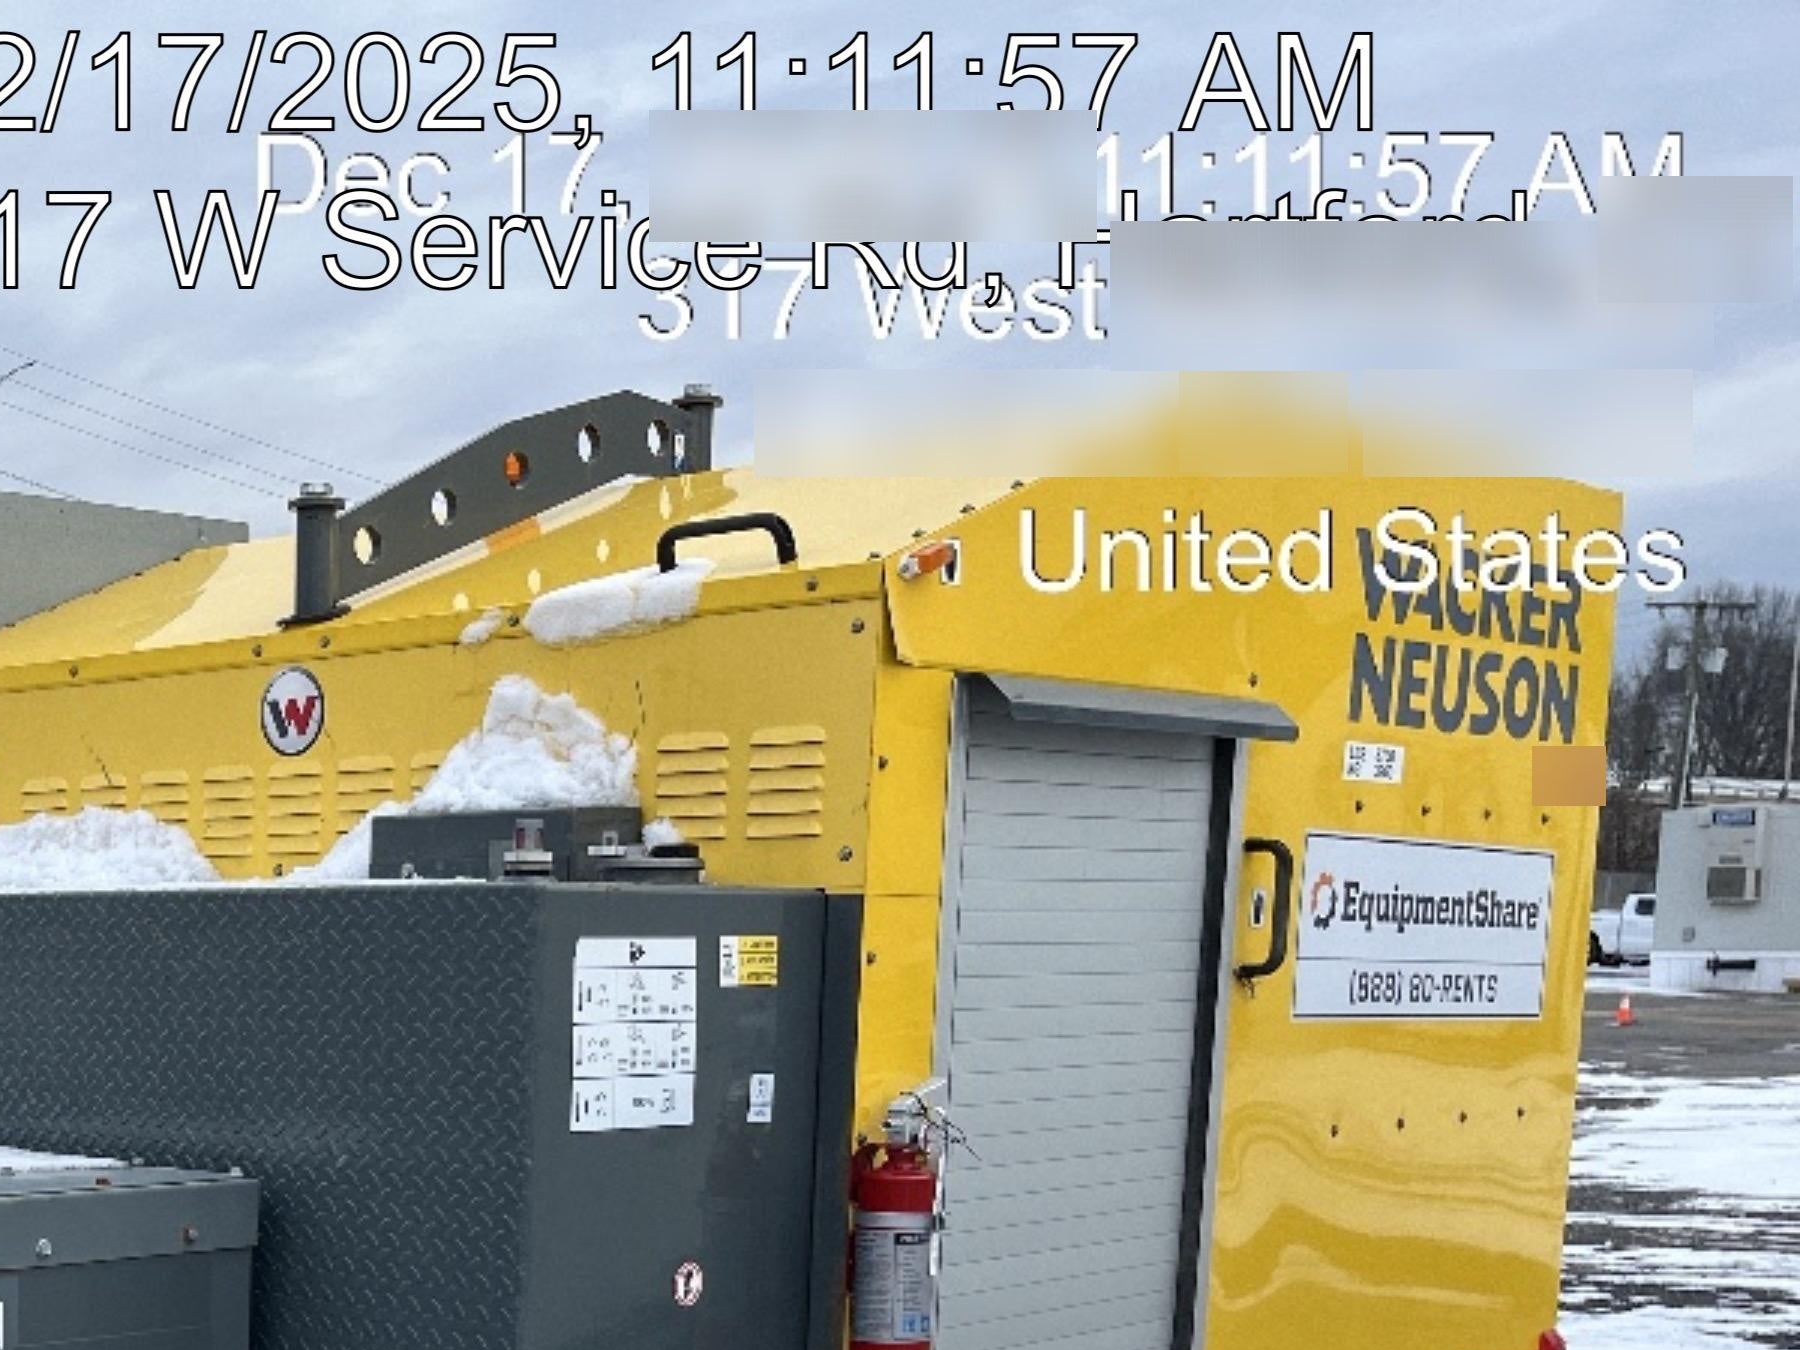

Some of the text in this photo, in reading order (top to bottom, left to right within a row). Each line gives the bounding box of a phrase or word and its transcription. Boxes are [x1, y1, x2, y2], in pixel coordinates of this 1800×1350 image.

[1356, 528, 1581, 654] WACKER
[1348, 632, 1580, 744] NEUSON
[1340, 880, 1538, 933] EquipmentShare
